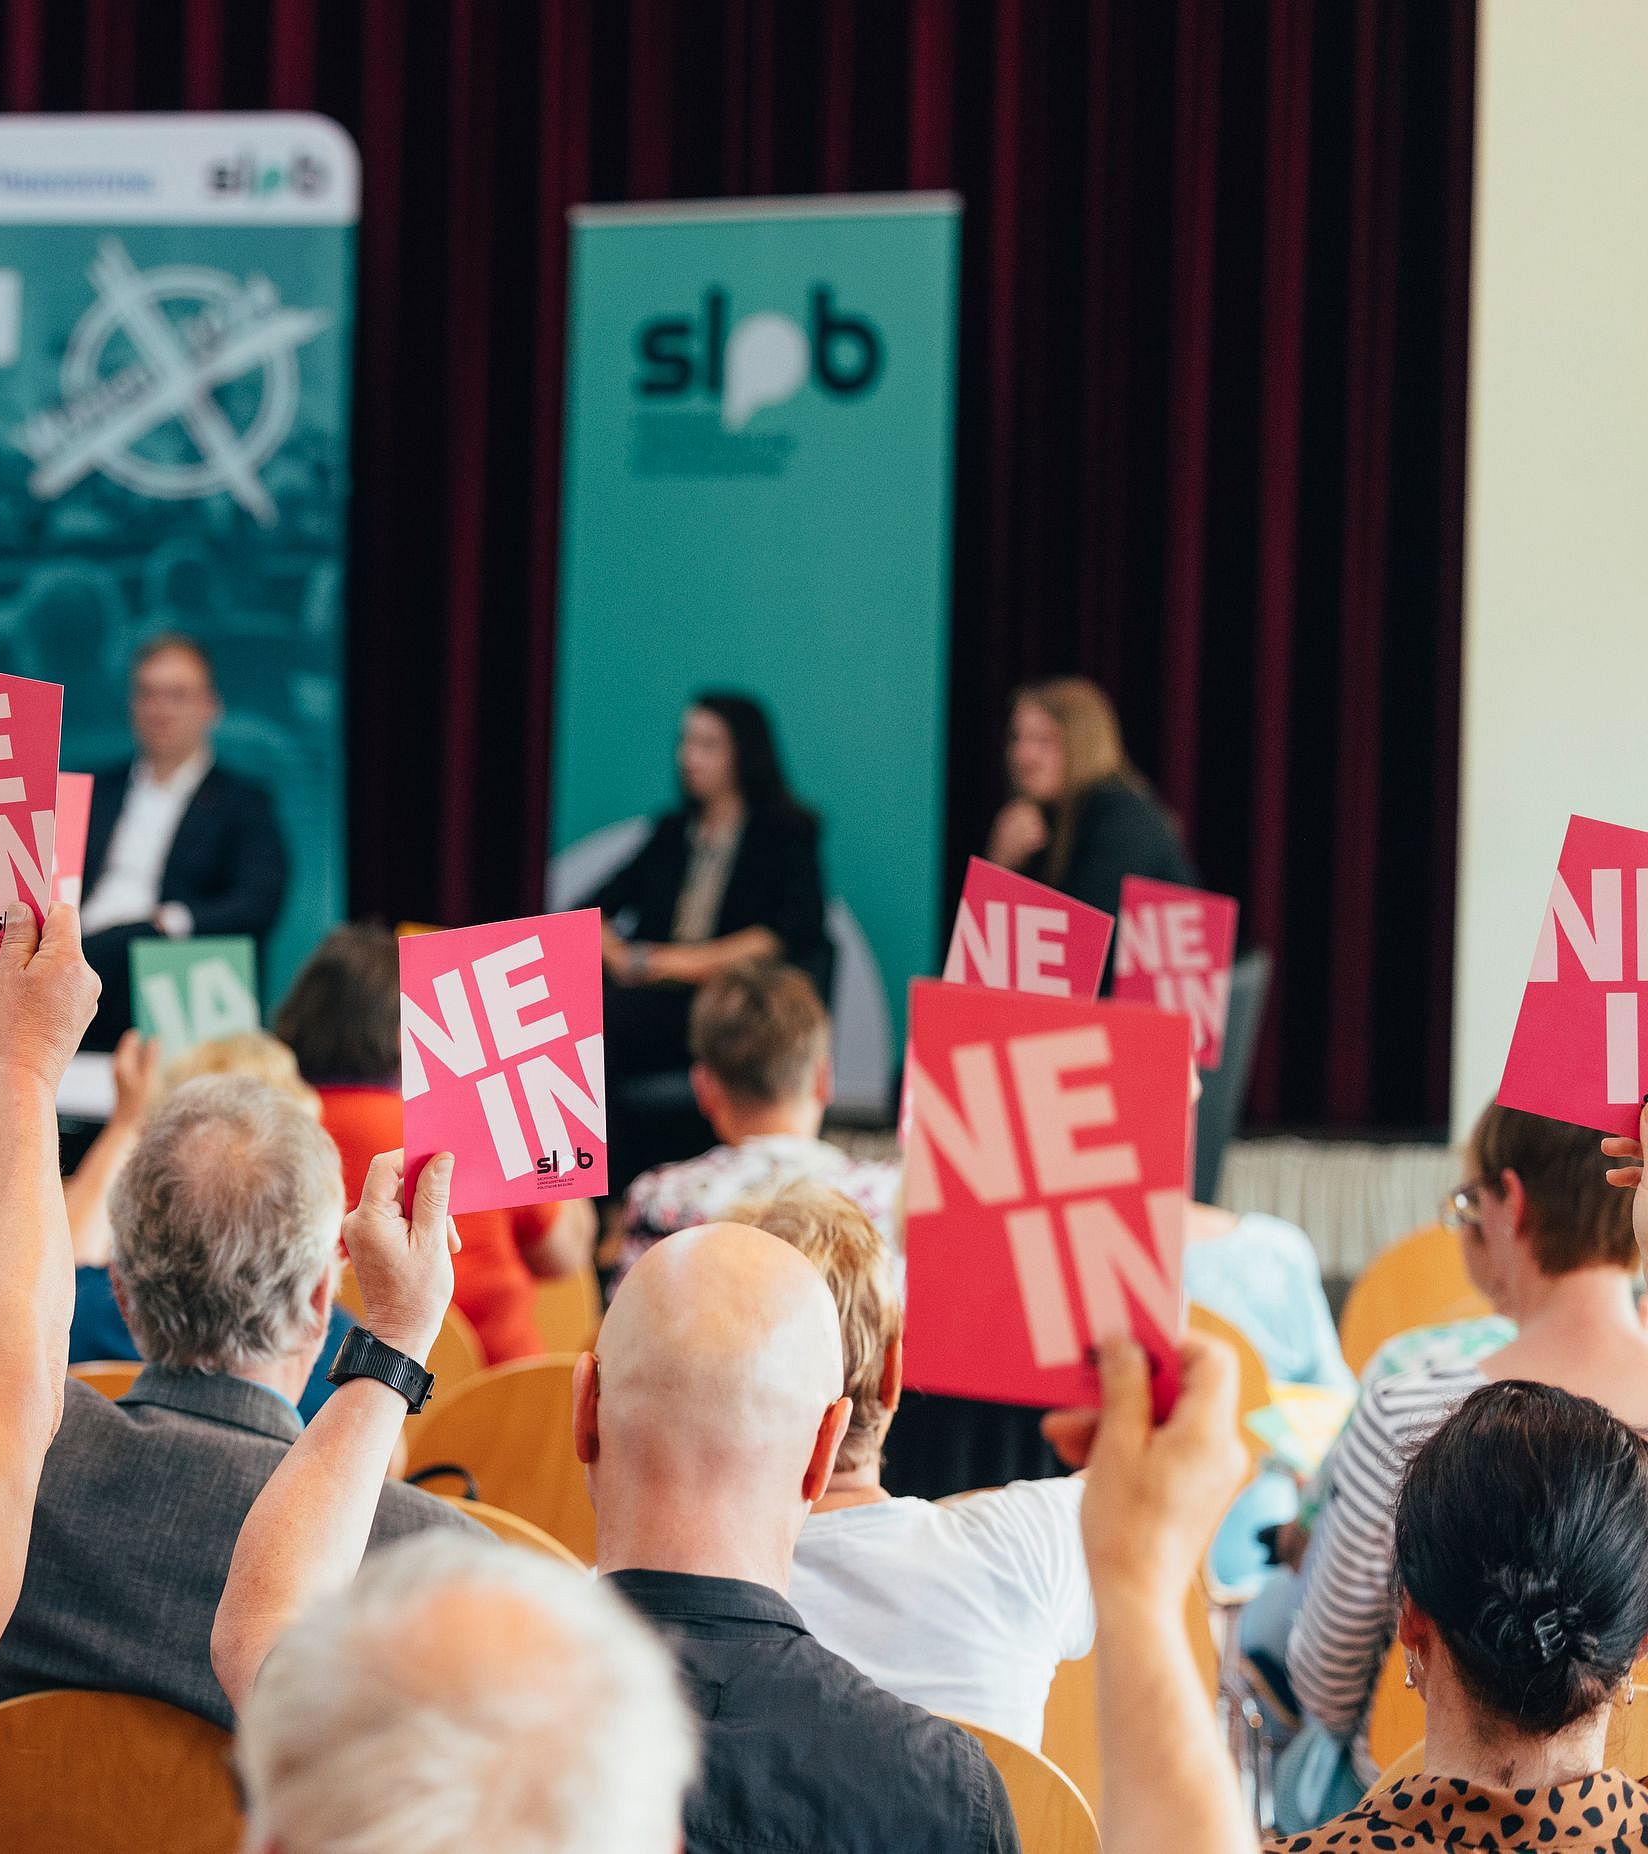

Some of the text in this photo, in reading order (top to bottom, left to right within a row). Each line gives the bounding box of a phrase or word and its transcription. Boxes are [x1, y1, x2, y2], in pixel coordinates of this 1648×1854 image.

[942, 899, 1072, 998] NE
[1113, 901, 1212, 978] NE
[1527, 868, 1648, 983] N
[401, 935, 570, 1103] NE
[475, 1031, 607, 1182] IN
[905, 1024, 1142, 1216] NE
[1004, 1189, 1187, 1370] IN
